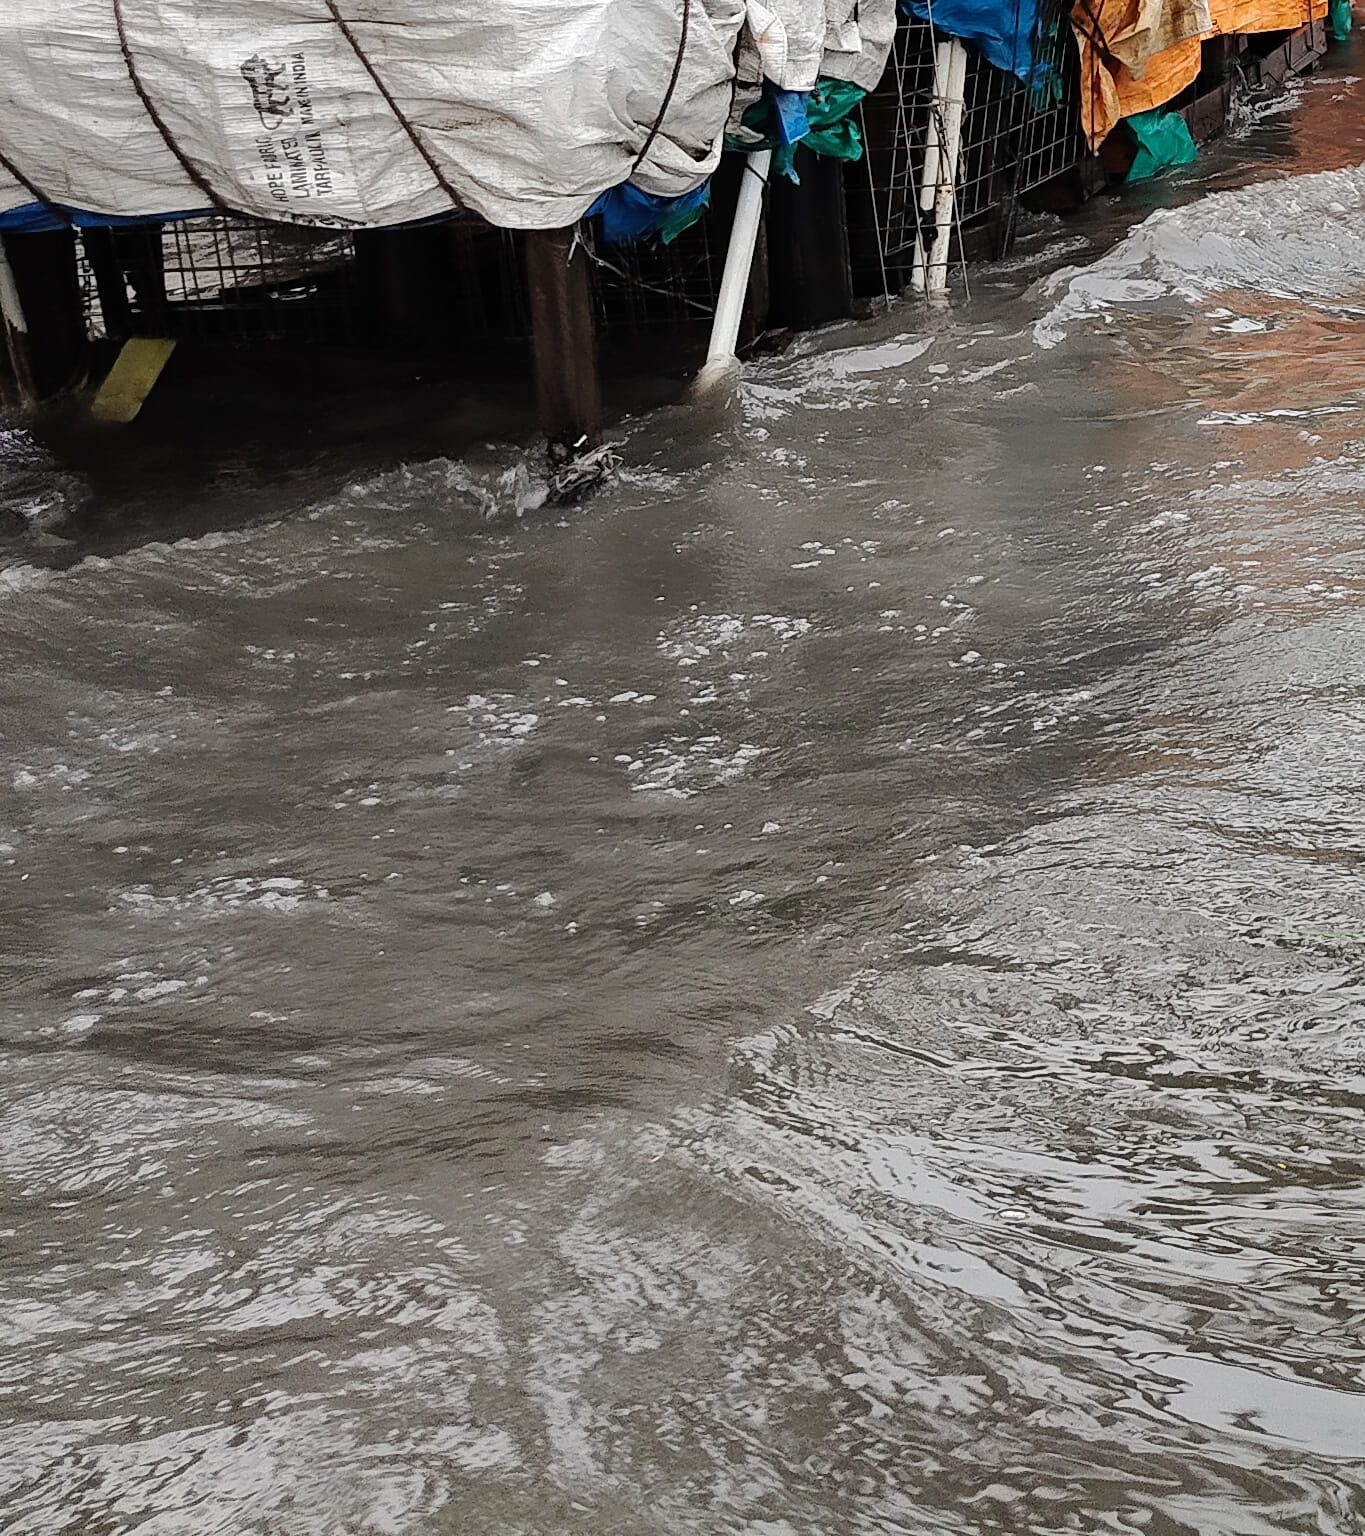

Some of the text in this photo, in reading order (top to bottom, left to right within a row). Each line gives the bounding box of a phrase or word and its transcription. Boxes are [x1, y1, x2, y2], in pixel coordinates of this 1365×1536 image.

[292, 52, 307, 84] INDIA
[266, 173, 290, 202] HOPE
[281, 136, 312, 199] LAMINATED
[305, 131, 334, 198] TARPAULIN
